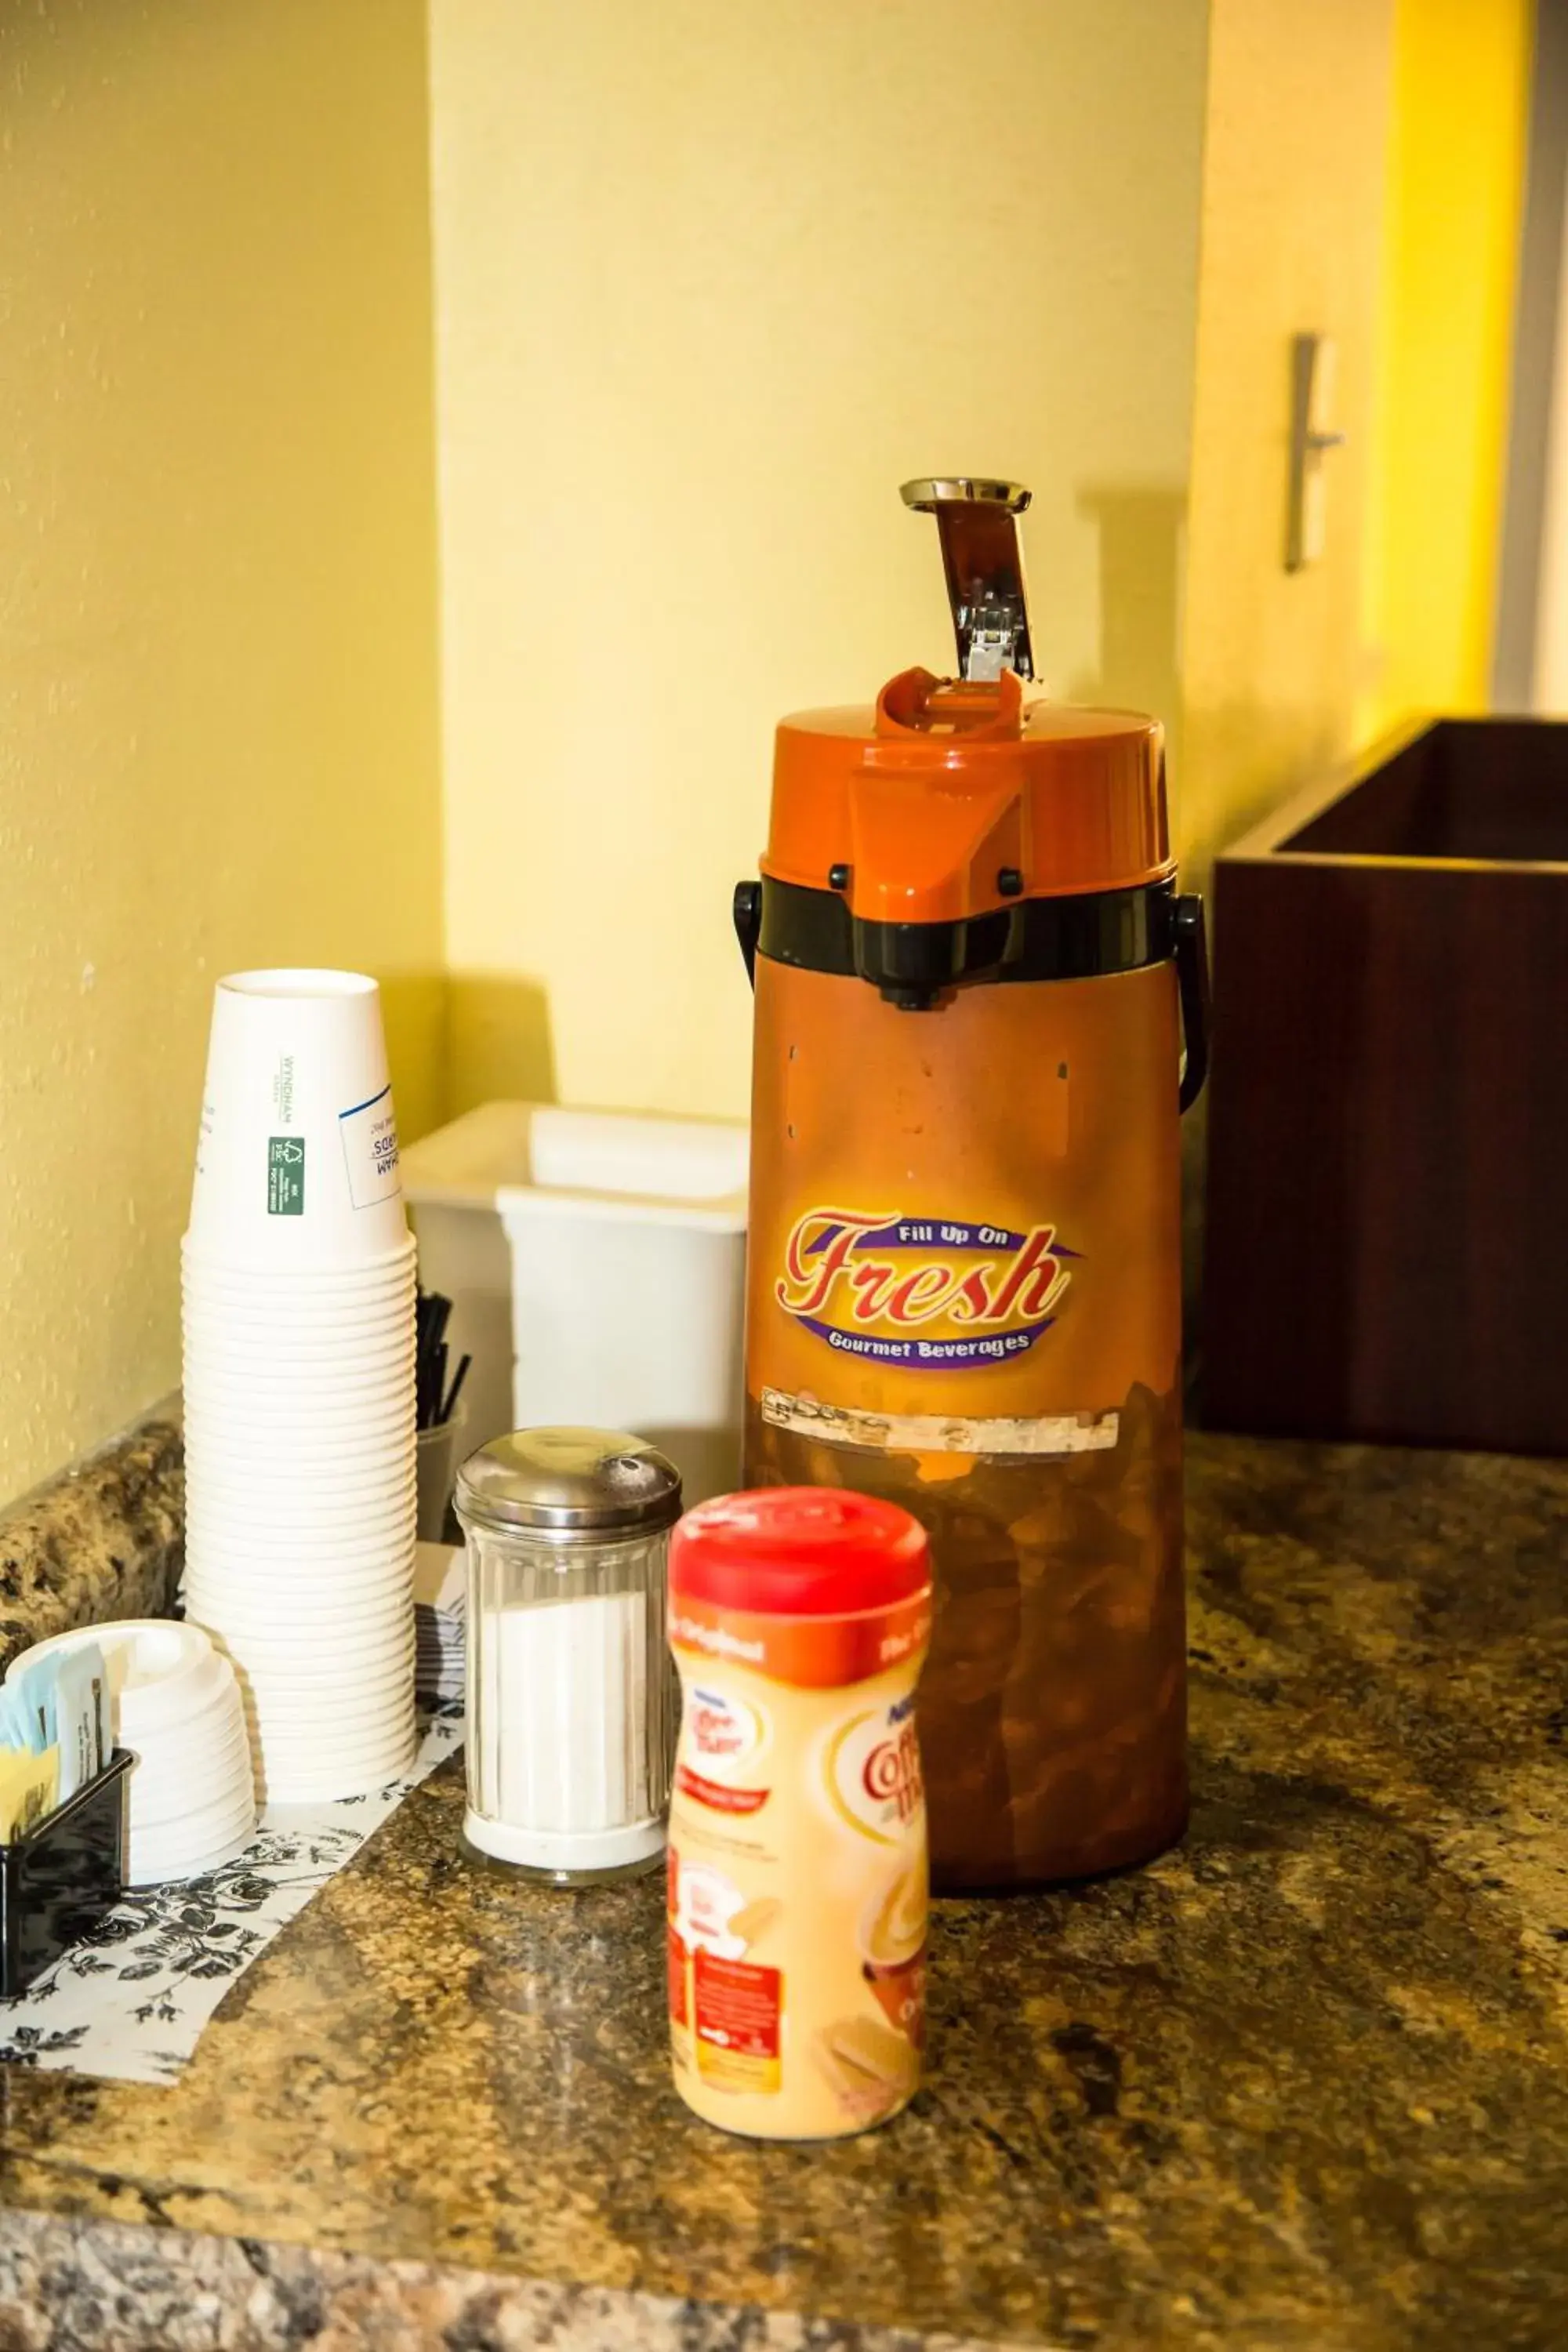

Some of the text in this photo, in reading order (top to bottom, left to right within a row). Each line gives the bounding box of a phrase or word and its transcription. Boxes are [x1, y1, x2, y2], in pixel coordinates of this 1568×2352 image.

[282, 1055, 295, 1123] WYNDHAM
[898, 1225, 1009, 1245] Fill Up On
[775, 1207, 1070, 1325] Fresh
[829, 1331, 1030, 1357] Gourmet Beverages
